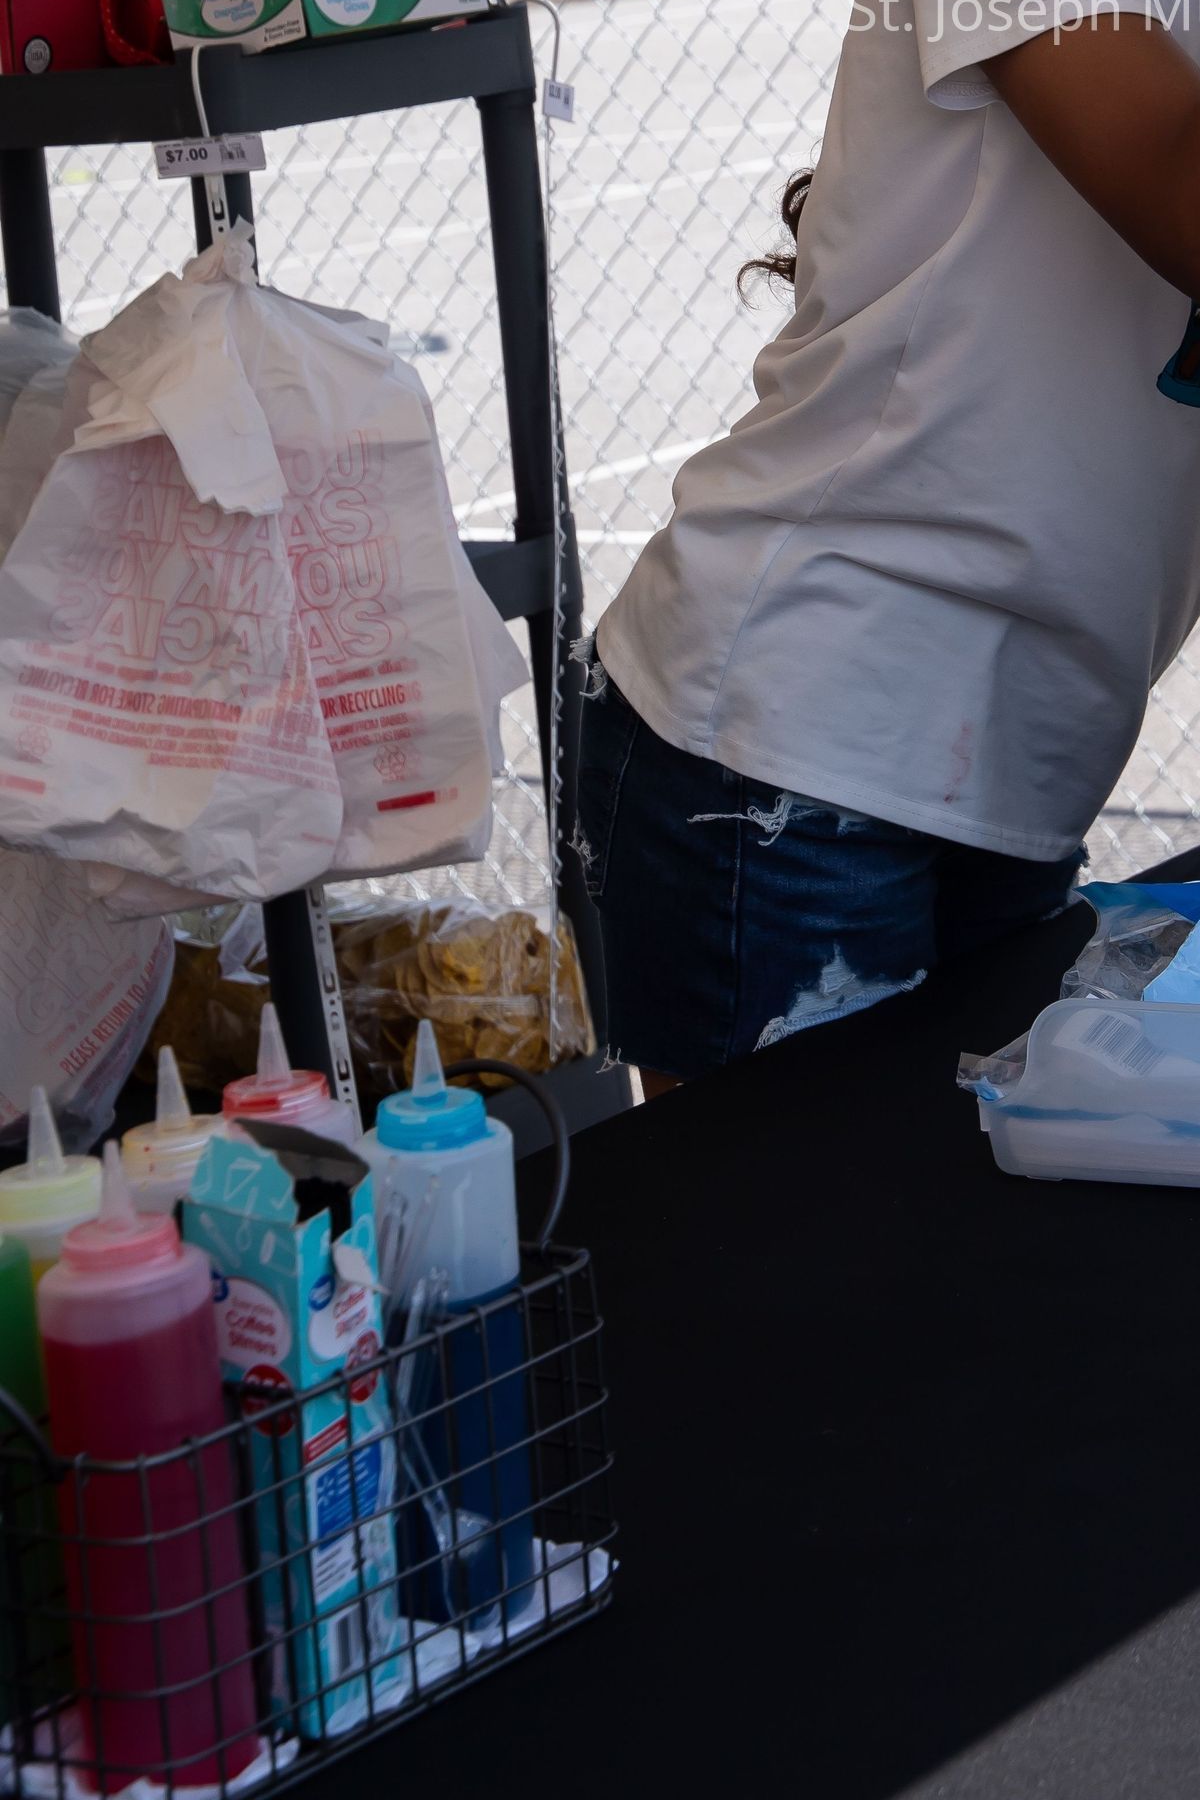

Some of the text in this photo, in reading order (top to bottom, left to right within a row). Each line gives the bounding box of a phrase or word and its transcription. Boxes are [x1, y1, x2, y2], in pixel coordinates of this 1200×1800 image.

[165, 147, 208, 163] $7.00
[319, 681, 407, 721] OR RECYCLING
[60, 1036, 98, 1077] PLEASE
[91, 996, 134, 1044] RETURN
[226, 1309, 276, 1336] Coffee
